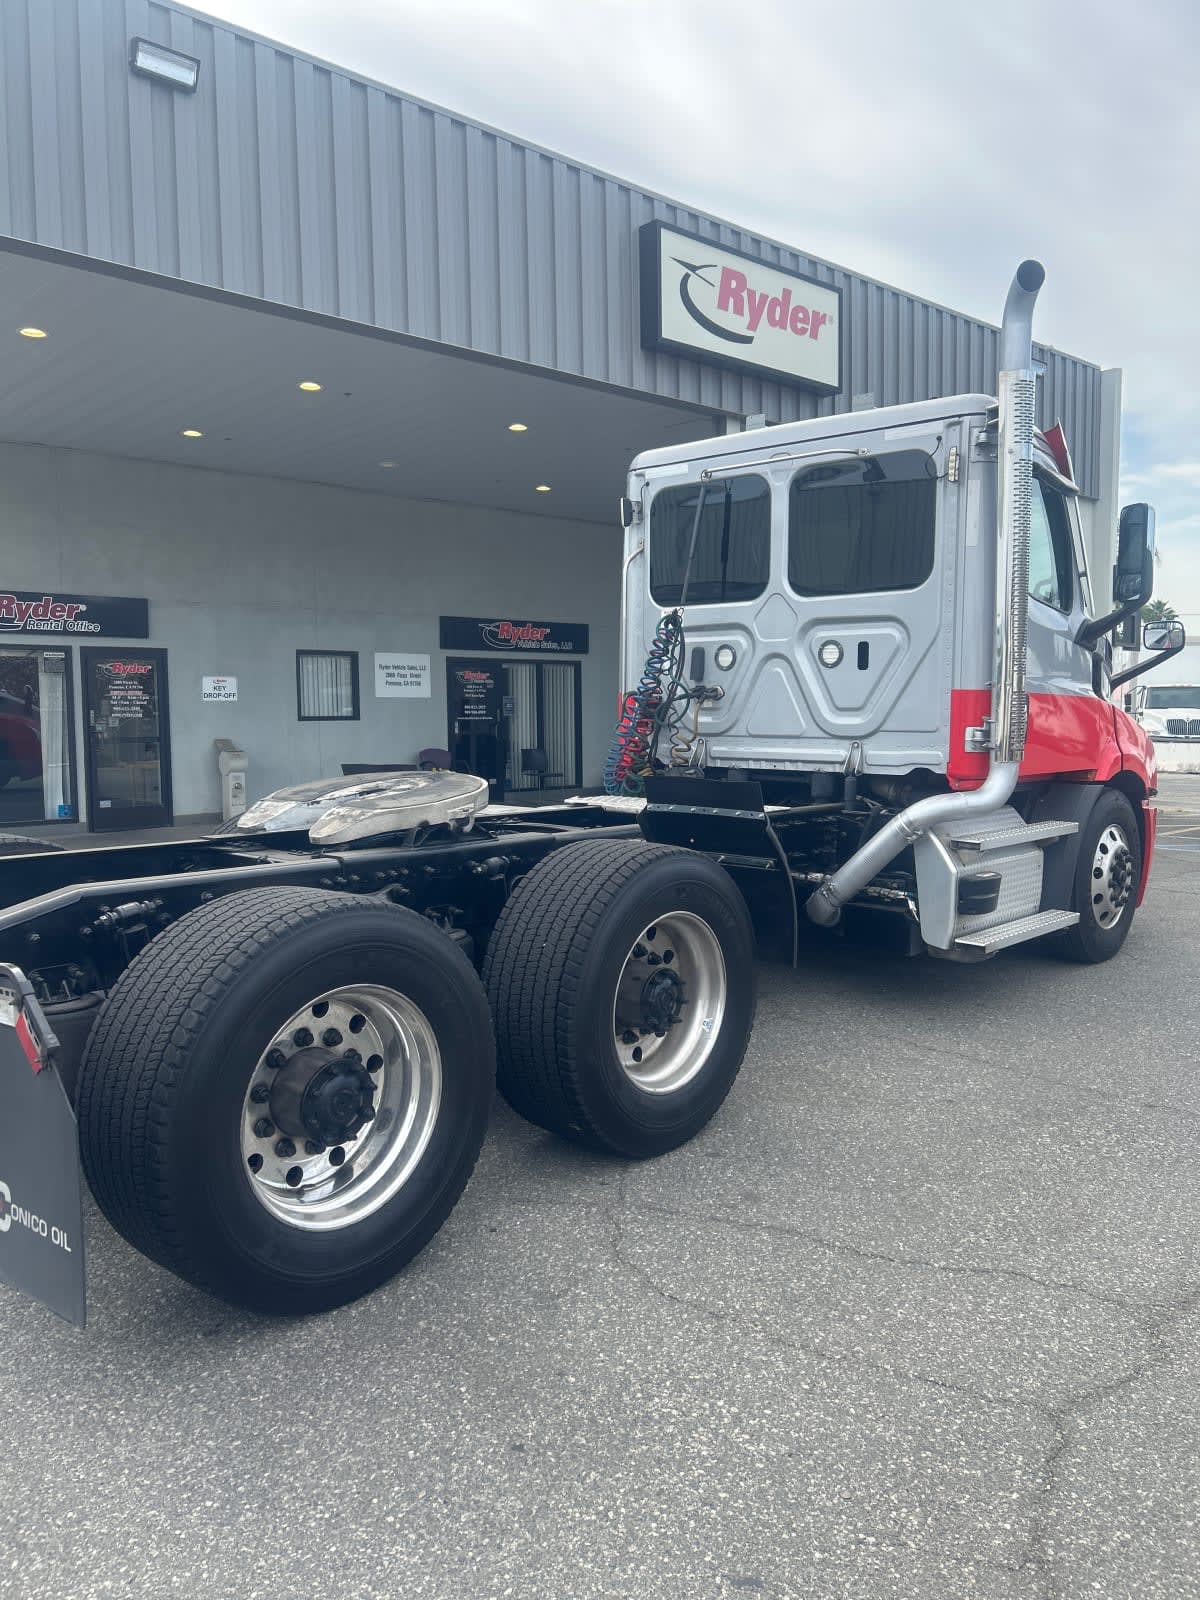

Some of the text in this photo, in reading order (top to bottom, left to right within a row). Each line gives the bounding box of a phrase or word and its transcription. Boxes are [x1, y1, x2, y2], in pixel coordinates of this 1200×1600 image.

[717, 266, 827, 340] Ryder
[0, 594, 80, 623] Ryder
[27, 619, 100, 632] Rental Office
[498, 621, 548, 645] Ryder
[111, 663, 150, 676] Ryder
[51, 1226, 71, 1252] OIL
